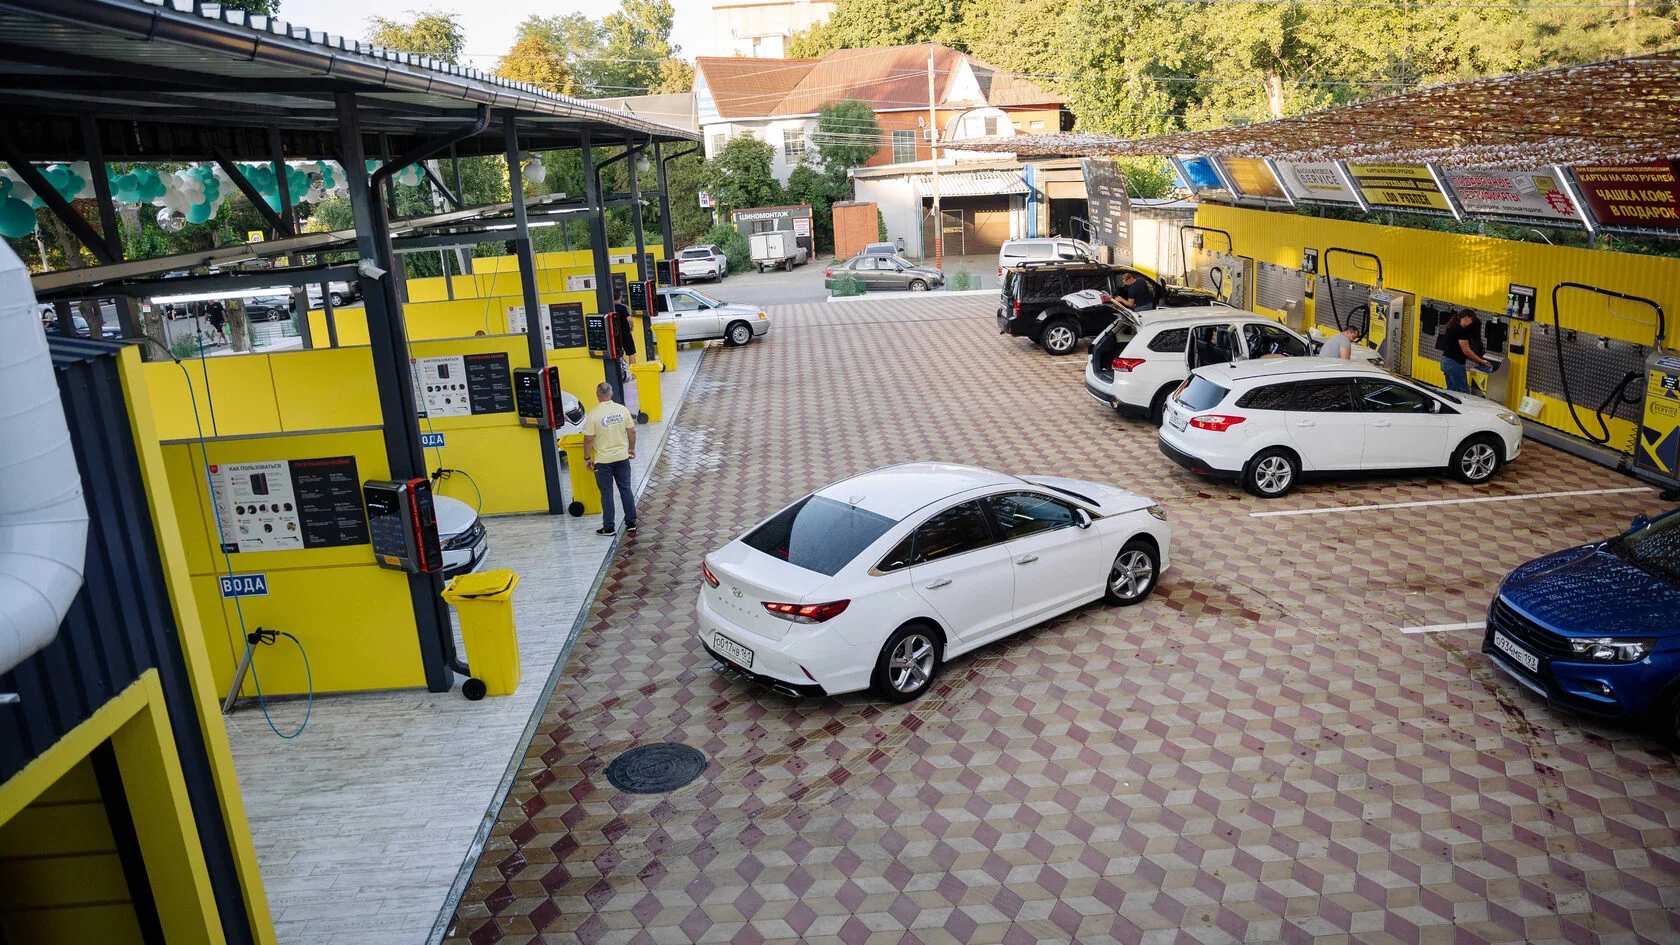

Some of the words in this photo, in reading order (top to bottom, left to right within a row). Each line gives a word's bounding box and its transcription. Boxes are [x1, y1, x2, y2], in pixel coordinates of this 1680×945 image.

[1300, 175, 1340, 185] SERVICE
[1452, 177, 1513, 188] ПОДАРОЧНЫЕ
[1579, 174, 1609, 182] КАРТЫ
[1610, 174, 1622, 182] НА
[1623, 174, 1639, 182] 500
[1640, 173, 1675, 182] РУБЛЕЙ
[1382, 192, 1398, 203] 100
[1399, 192, 1432, 205] РУБЛЕЙ
[1459, 189, 1521, 202] СЕРТИФИКАТЫ
[1596, 189, 1639, 201] ЧАШКА
[1639, 190, 1676, 202] КОФЕ
[739, 211, 789, 220] ШИНОМОНТАЖ
[1609, 205, 1620, 216] В
[1620, 205, 1680, 220] ПОДАРОК
[422, 434, 444, 446] ОДА
[222, 577, 265, 593] ВОДА
[1523, 653, 1536, 667] 193
